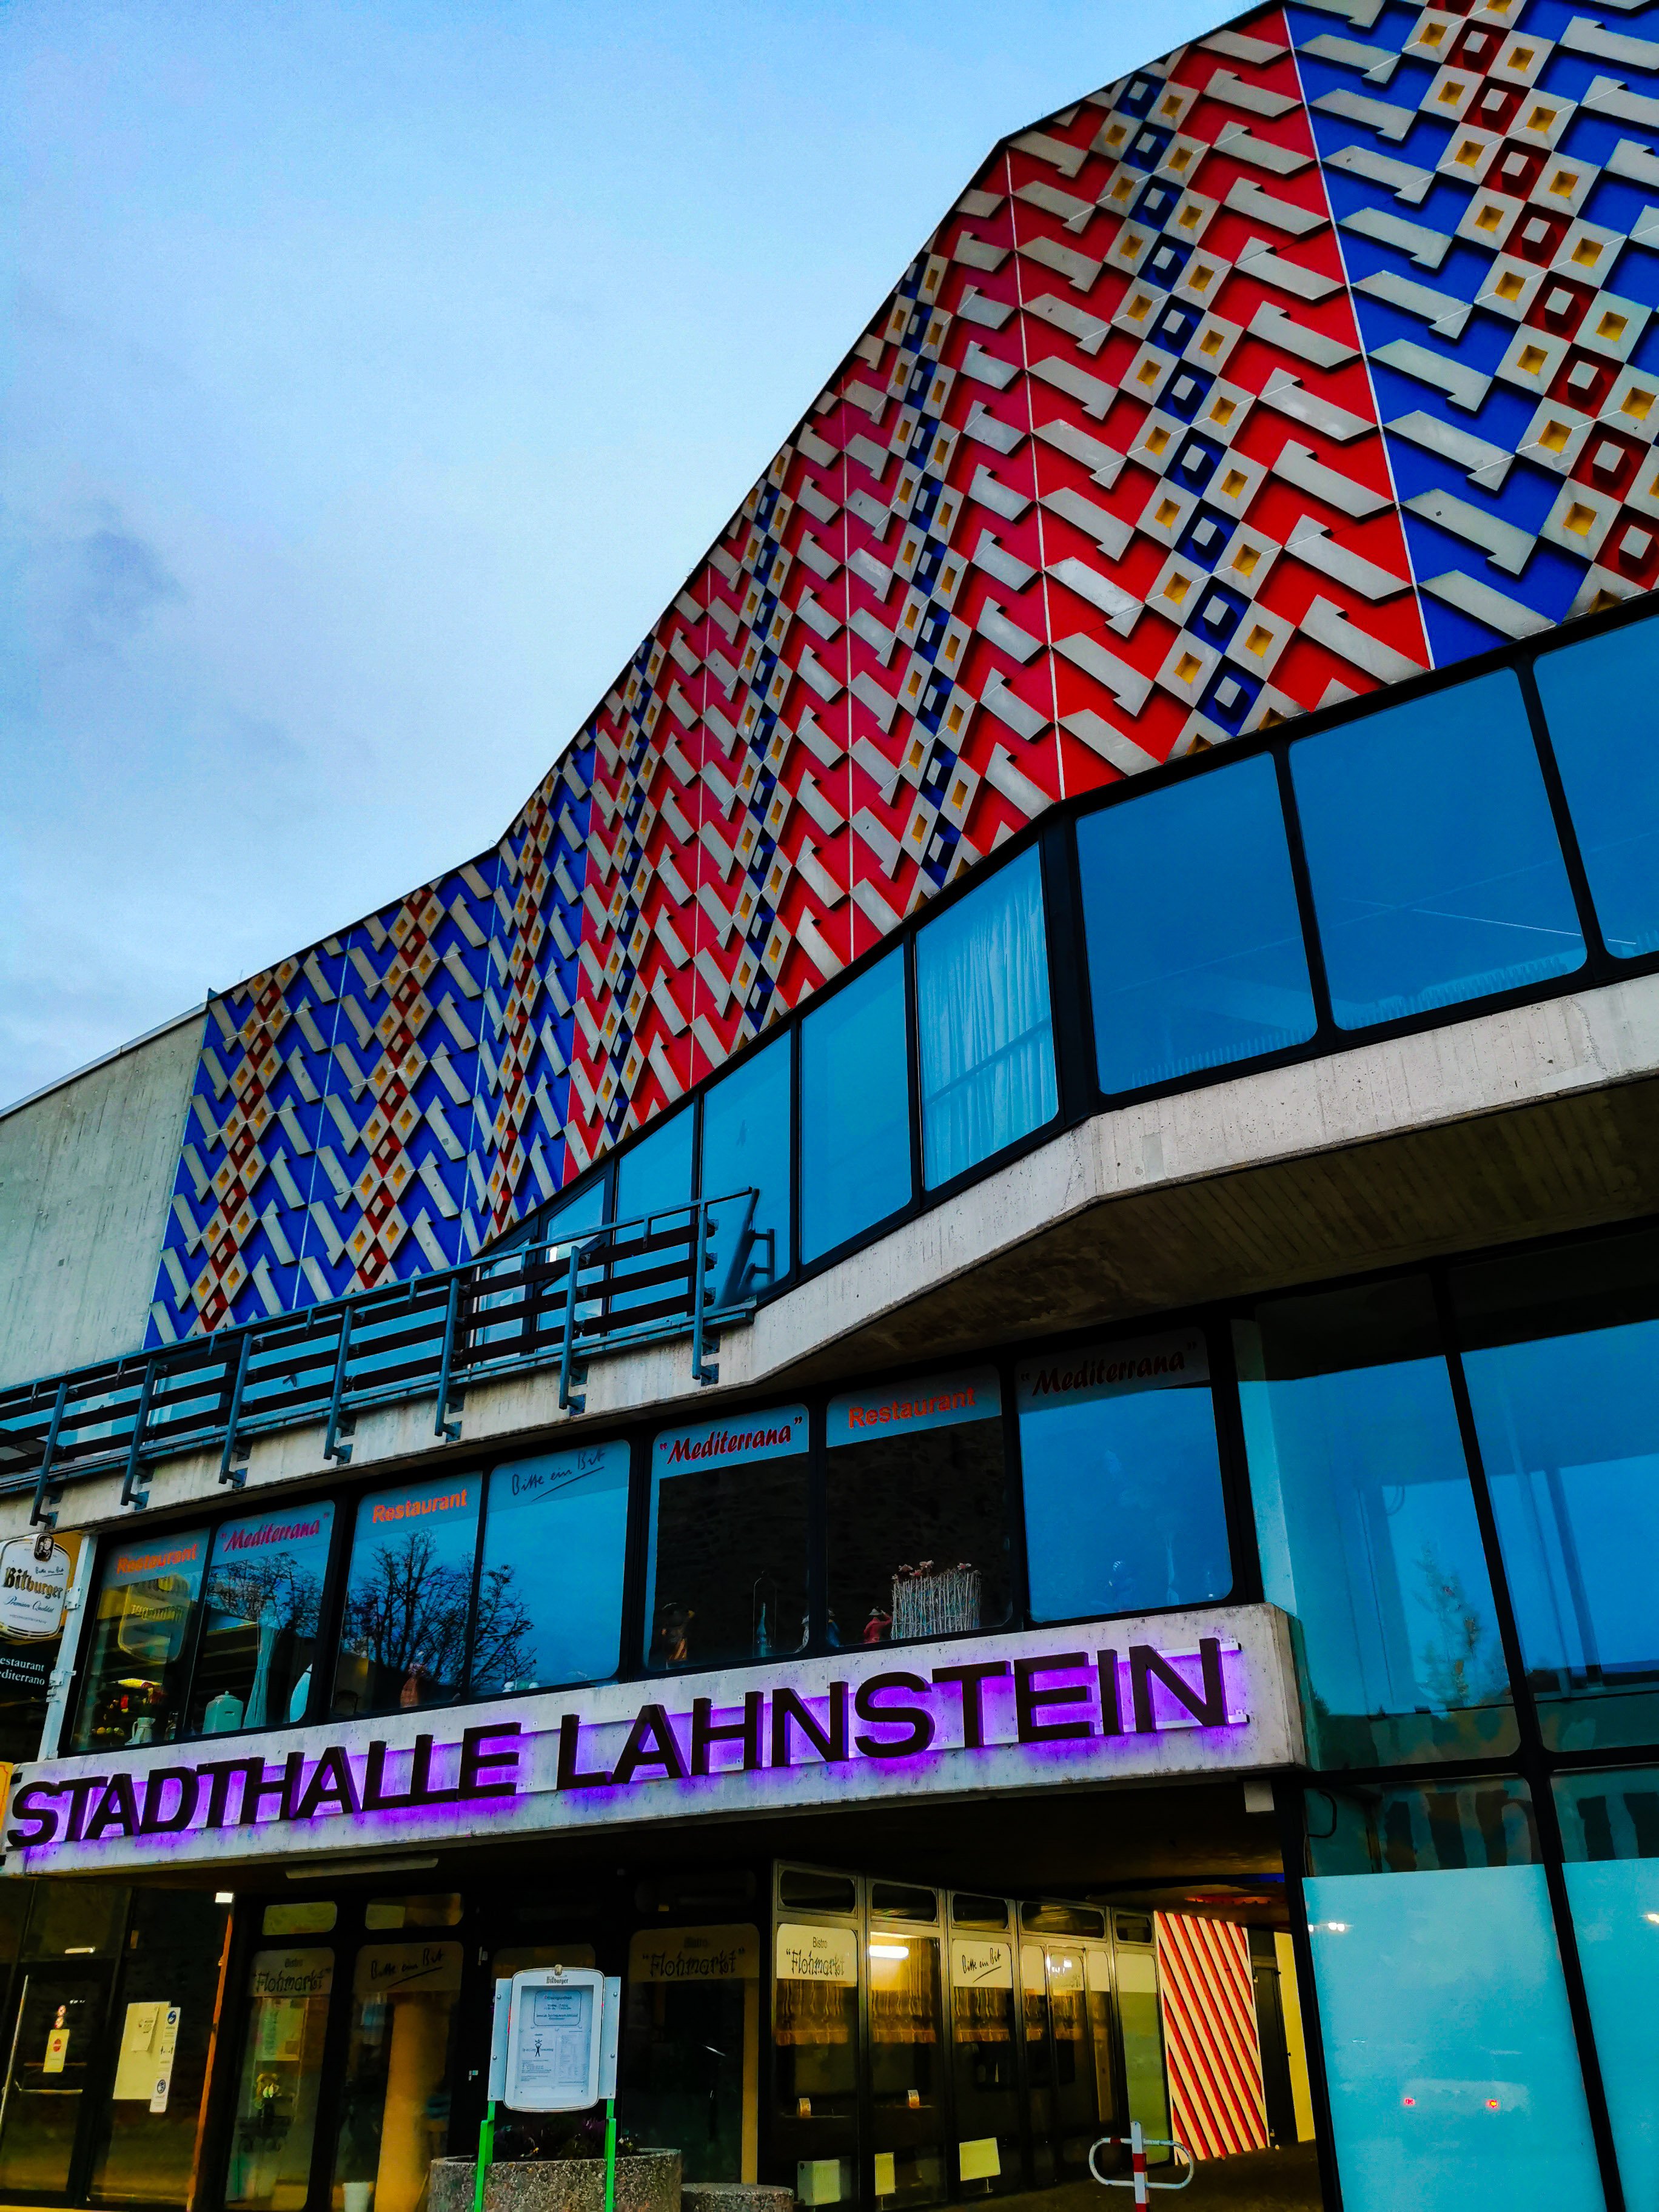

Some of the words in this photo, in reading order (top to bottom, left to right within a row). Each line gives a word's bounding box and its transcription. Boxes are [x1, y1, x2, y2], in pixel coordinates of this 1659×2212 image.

[849, 1387, 977, 1429] Restaurant
[511, 1472, 544, 1496] Bitte
[550, 1468, 573, 1482] ein
[577, 1448, 606, 1471] Bit
[372, 1489, 468, 1523] Restaurant
[117, 1543, 198, 1575] Restaurant
[3, 1566, 64, 1600] Bitburger
[4, 1595, 31, 1609] Premium
[0, 1657, 45, 1672] estaurant
[7, 1721, 521, 1848] STADTHALLE
[557, 1636, 1230, 1790] LAHNSTEIN
[812, 1936, 828, 1949] Bistro
[962, 1954, 977, 1974] Bitte
[979, 1959, 989, 1969] ein
[990, 1947, 1001, 1965] Bit
[546, 1976, 569, 1985] Bitburger
